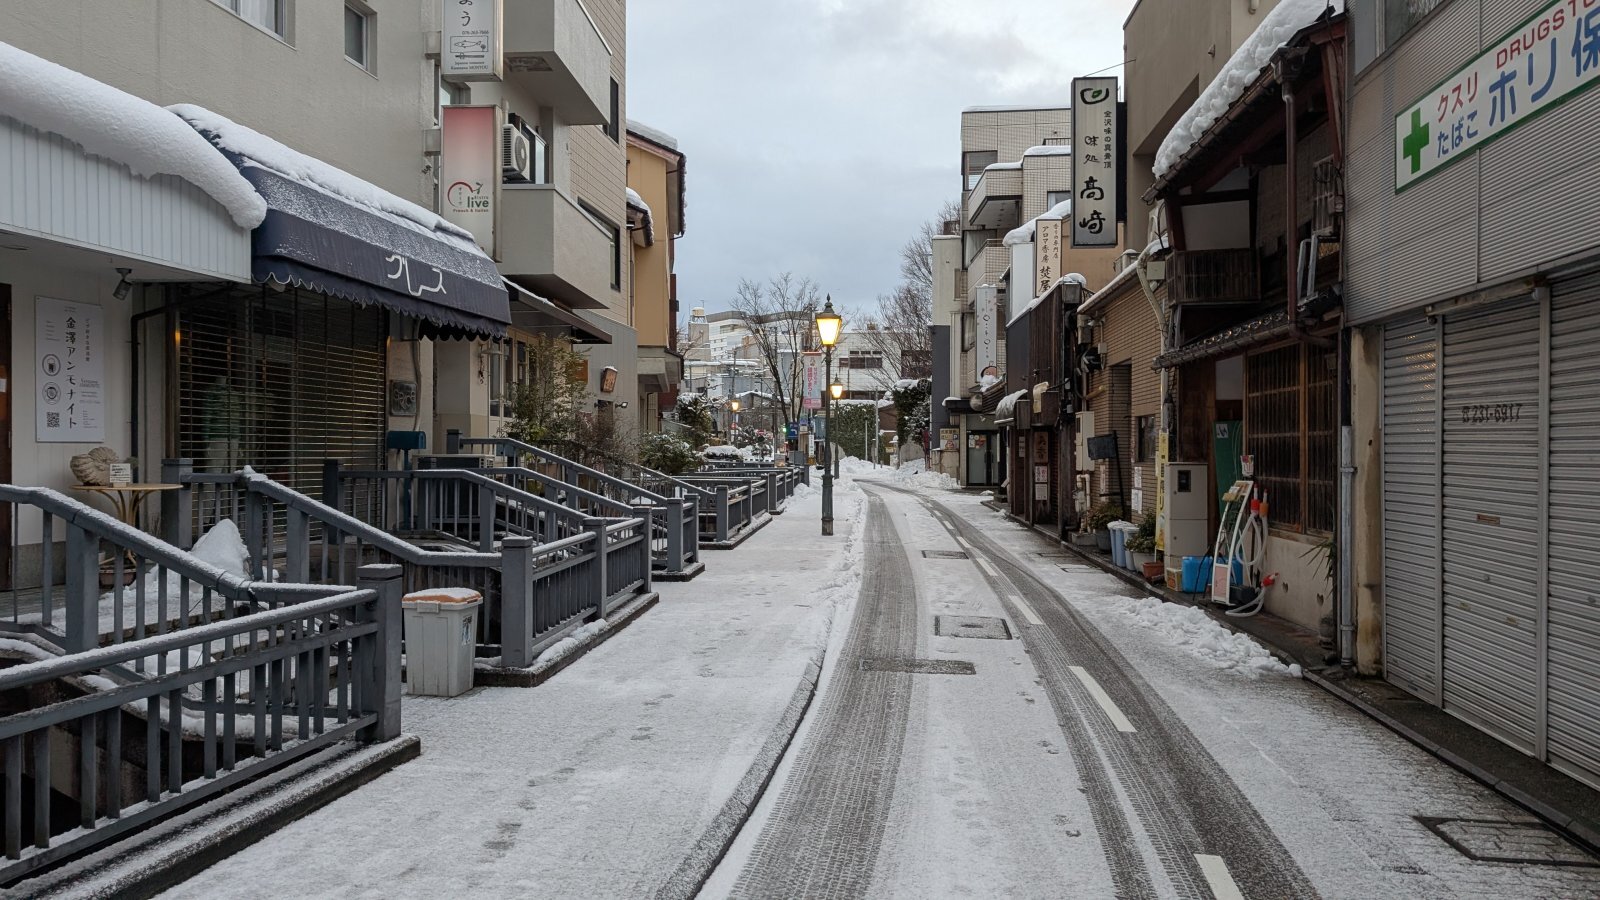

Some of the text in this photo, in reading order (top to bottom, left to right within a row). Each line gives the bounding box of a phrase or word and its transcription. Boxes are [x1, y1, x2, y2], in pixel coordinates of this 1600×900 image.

[1437, 71, 1478, 123] クスリ
[1084, 136, 1100, 165] 味処
[1103, 110, 1112, 169] 金沢味の真骨頂
[1437, 110, 1479, 158] たばこ
[65, 316, 77, 430] 金澤アンモナイト
